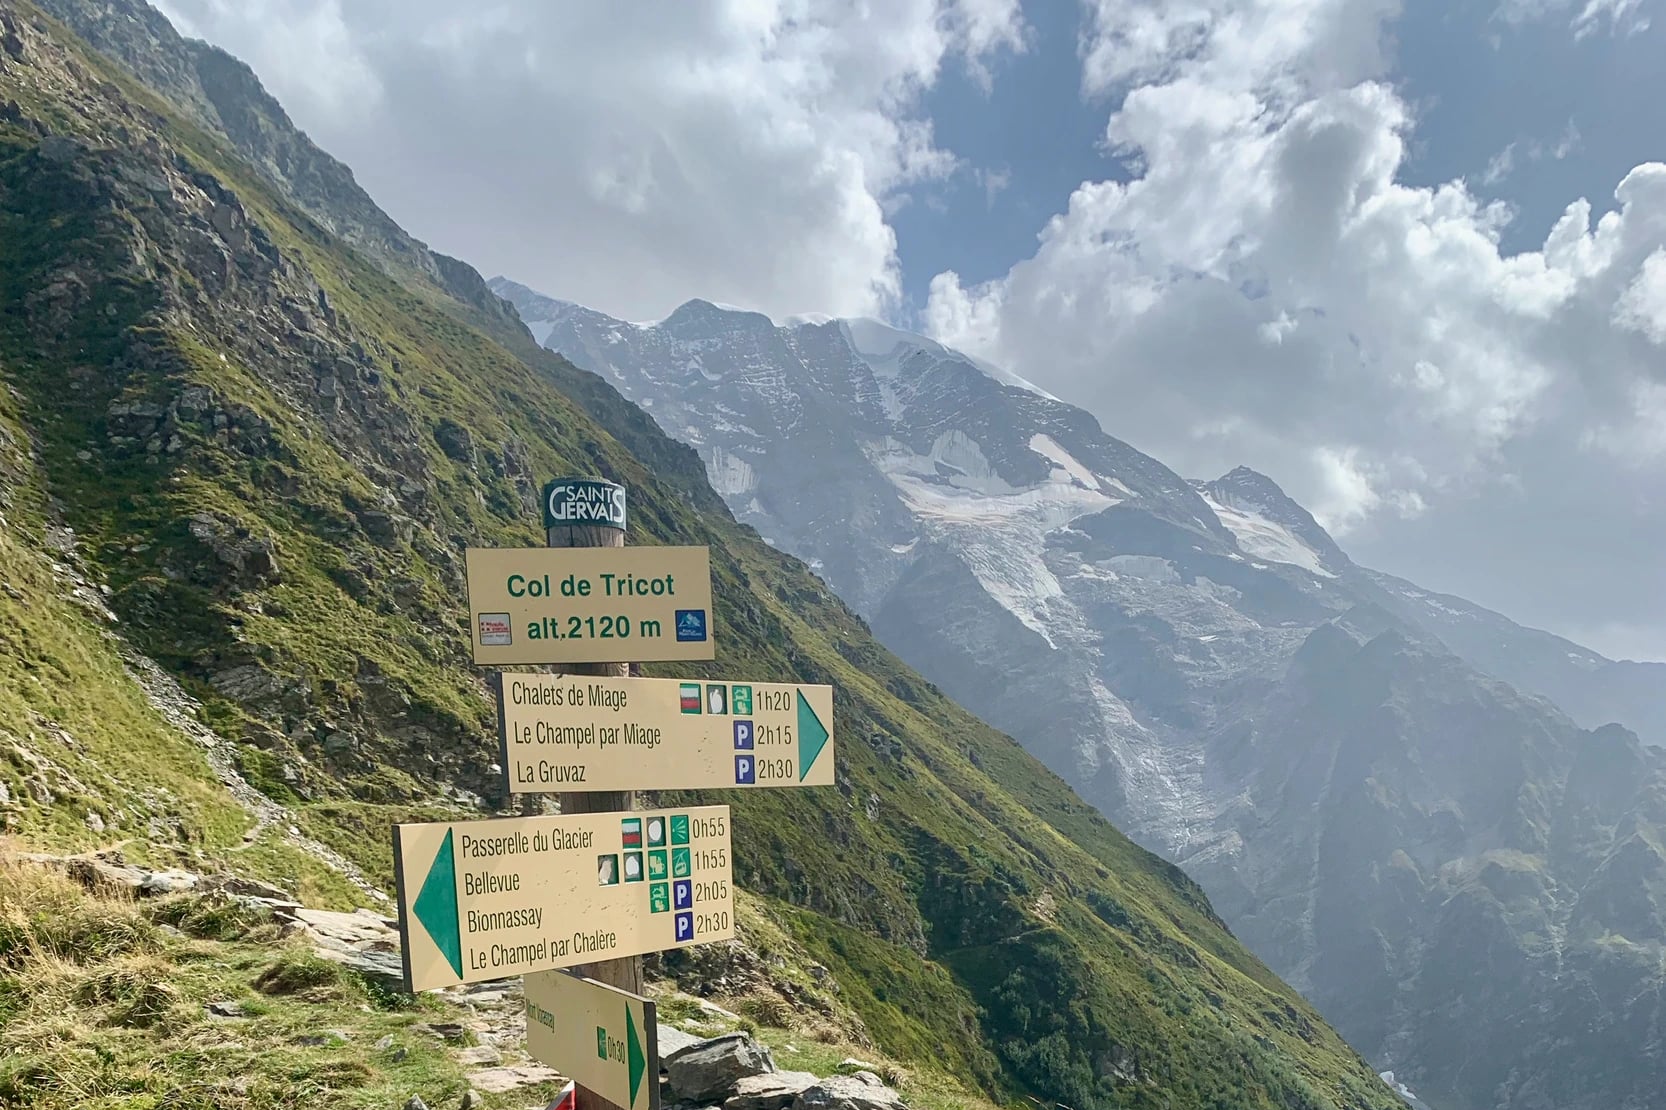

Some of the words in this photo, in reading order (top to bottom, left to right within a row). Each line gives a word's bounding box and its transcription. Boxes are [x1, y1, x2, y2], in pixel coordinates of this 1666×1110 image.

[549, 486, 624, 523] GERVAIS
[566, 485, 613, 503] SAINT
[507, 574, 550, 598] Col
[560, 574, 591, 597] de
[599, 573, 675, 596] Tricot
[640, 619, 661, 637] m
[512, 681, 563, 706] Chalets
[568, 684, 584, 706] de
[588, 684, 627, 712] Miage
[756, 691, 791, 712] 1h20
[514, 721, 532, 744] Le
[536, 721, 595, 749] Champel
[599, 727, 619, 749] par
[623, 723, 661, 749] Miage
[757, 725, 792, 745] 2h15
[516, 760, 535, 783] La
[539, 760, 586, 783] Gruvaz
[758, 759, 793, 779] 2h30
[462, 831, 529, 858] Passerelle
[533, 830, 549, 852] du
[552, 827, 594, 851] Glacier
[692, 817, 725, 839] 0h55
[465, 871, 520, 896] Bellevue
[694, 849, 727, 870] 1h55
[467, 907, 543, 933] Bionnassay
[695, 880, 727, 902] 2h05
[470, 948, 487, 970] Le
[490, 938, 547, 967] Champel
[550, 937, 570, 962] par
[573, 929, 617, 955] Chalère
[696, 912, 728, 934] 2h30
[607, 1036, 626, 1065] 0h30
